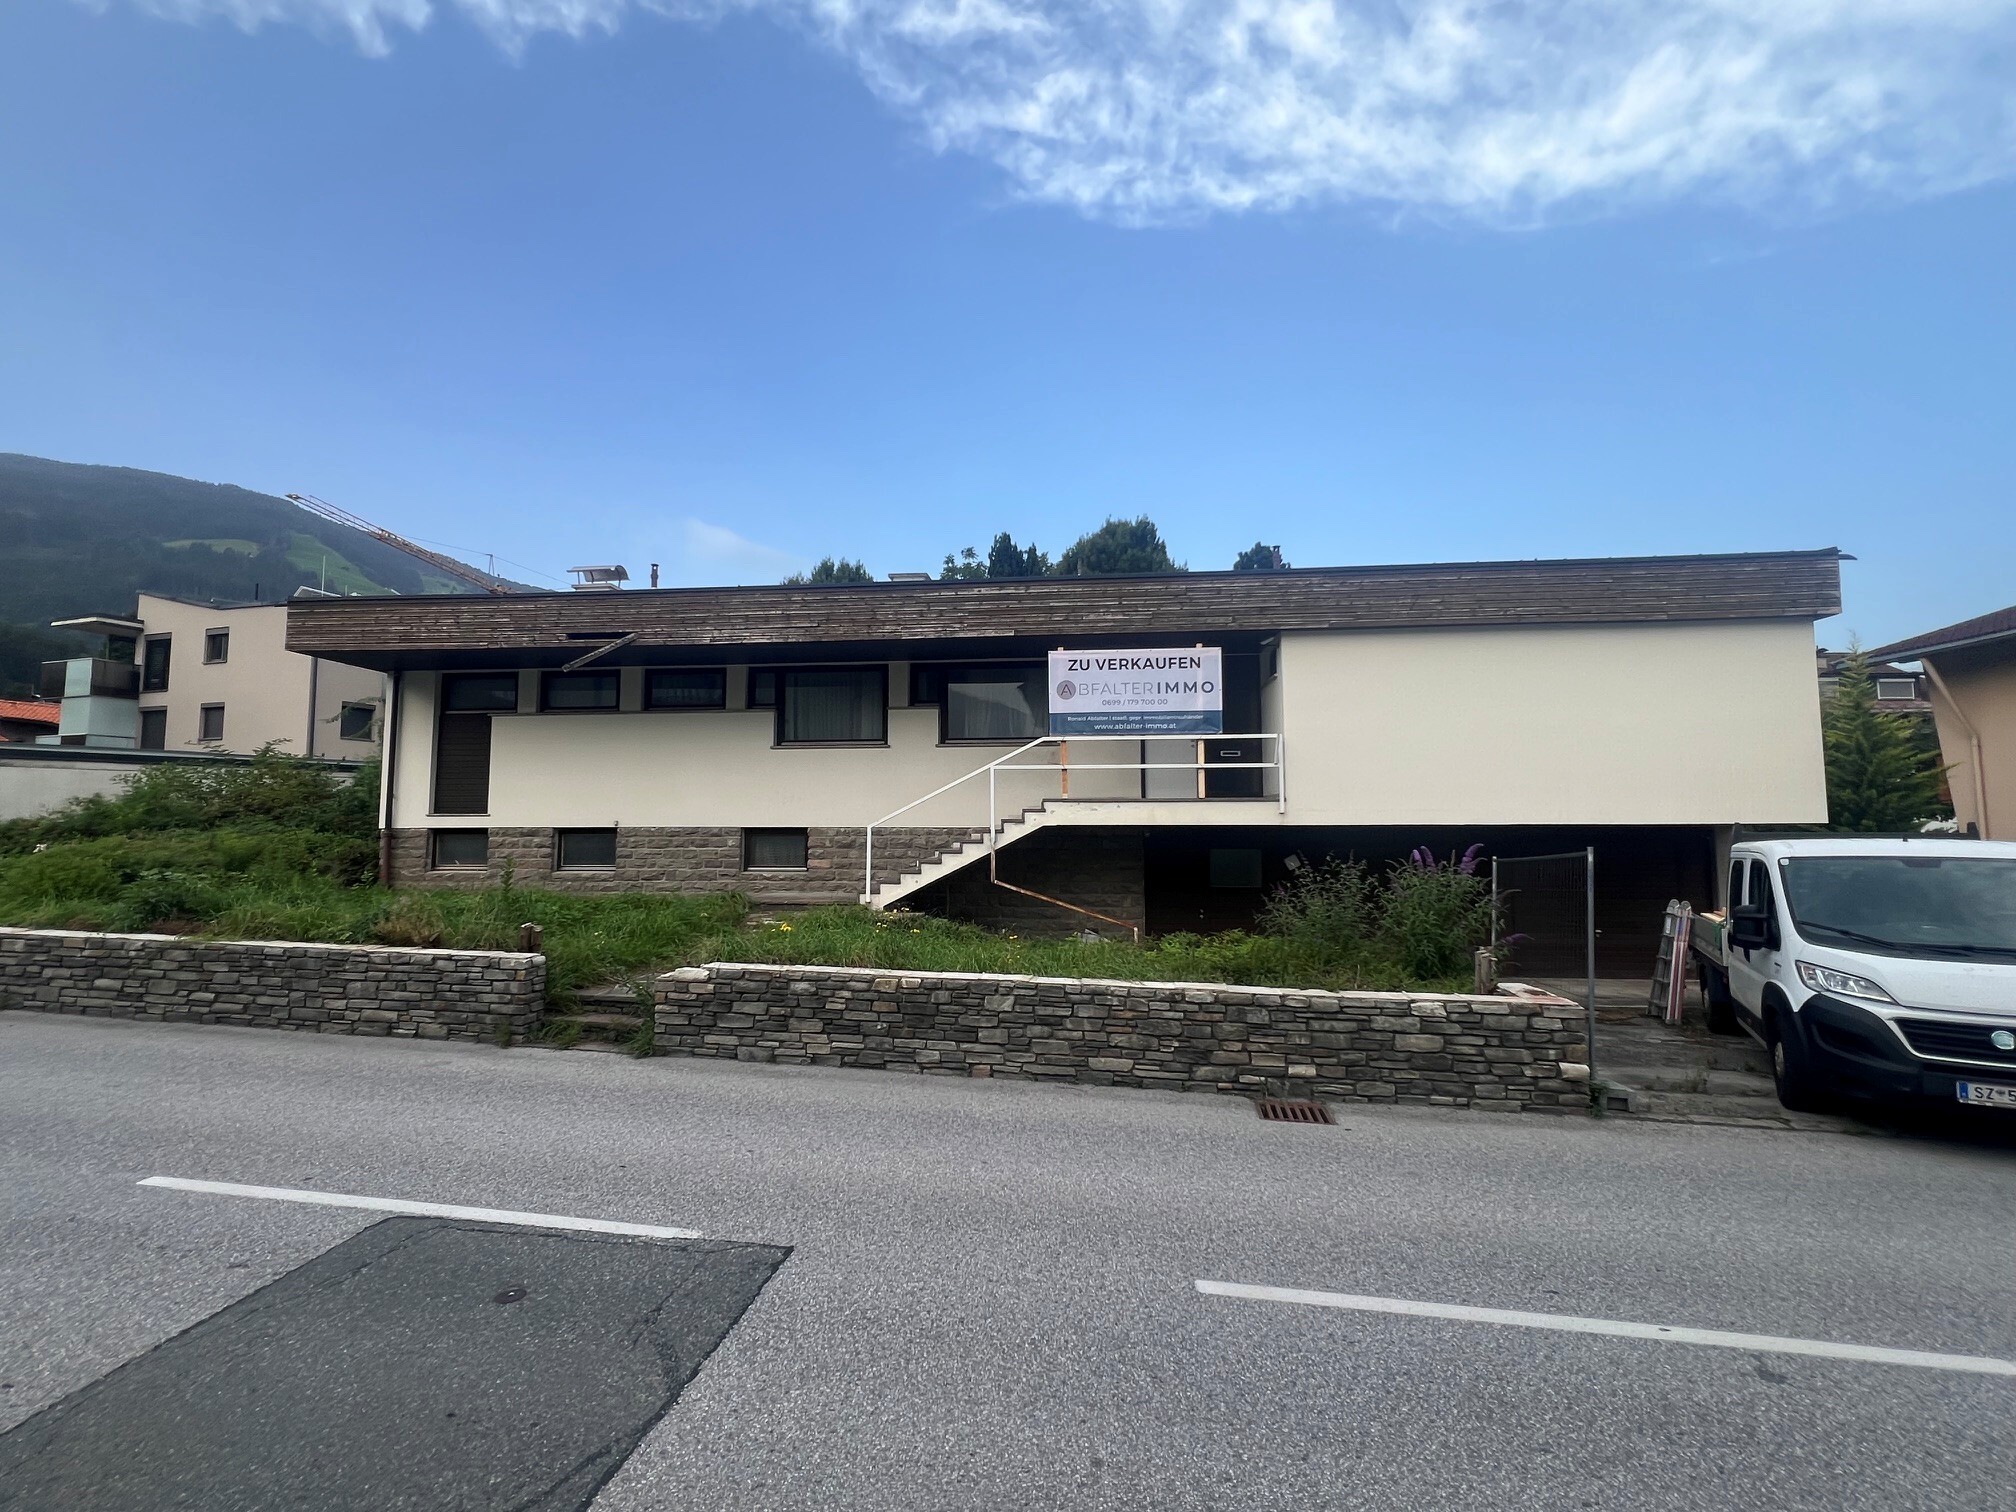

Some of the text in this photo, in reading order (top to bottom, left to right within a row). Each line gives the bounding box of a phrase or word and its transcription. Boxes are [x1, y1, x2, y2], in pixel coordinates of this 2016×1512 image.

[1068, 657, 1201, 671] ZU VERKAUFEN
[1093, 722, 1176, 730] www.abfalter-immo.at
[1975, 1086, 1994, 1100] SZ
